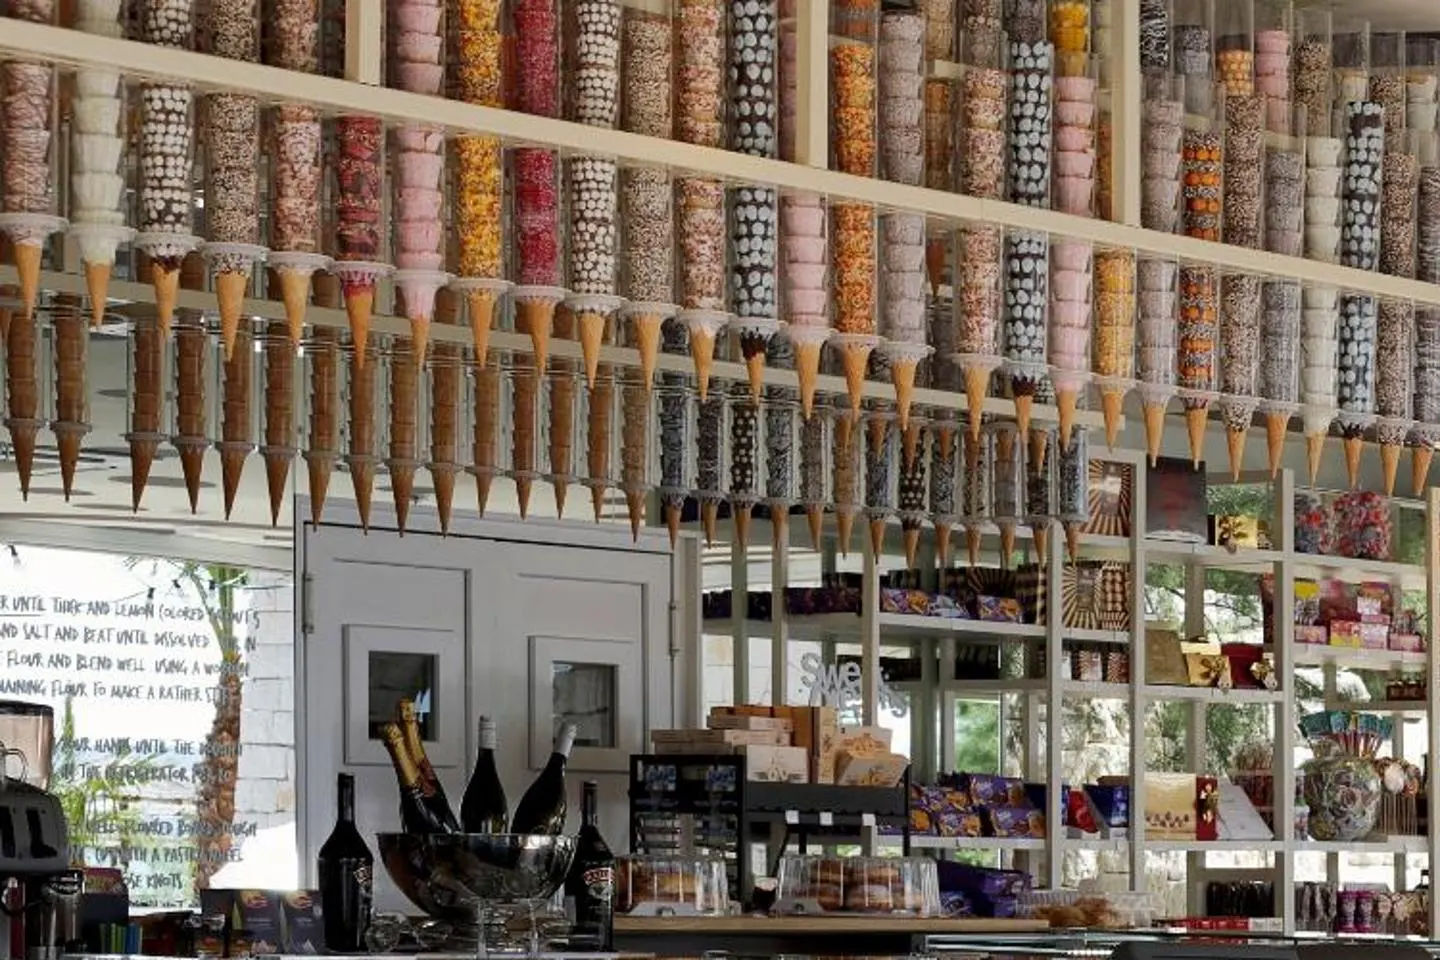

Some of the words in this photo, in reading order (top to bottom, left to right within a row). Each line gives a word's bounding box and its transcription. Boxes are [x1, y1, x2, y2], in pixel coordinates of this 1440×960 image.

[13, 594, 47, 612] UNTIL
[86, 600, 110, 616] AND
[22, 620, 53, 640] SALT
[54, 625, 79, 641] AND
[83, 626, 116, 644] BEAT
[116, 628, 149, 645] UNTIL
[154, 632, 210, 648] DISSOLVED
[7, 648, 44, 669] FLOUR
[48, 653, 72, 669] AND
[76, 653, 112, 671] BLEND
[117, 657, 146, 672] WELL
[155, 658, 188, 675] USING
[191, 660, 201, 675] A
[51, 679, 88, 698] FLOUR
[111, 684, 144, 700] MAKE
[147, 685, 155, 700] A
[159, 685, 202, 702] RATHER
[136, 739, 168, 756] UNTIL
[172, 739, 195, 756] THE
[146, 872, 183, 890] KNOTS
